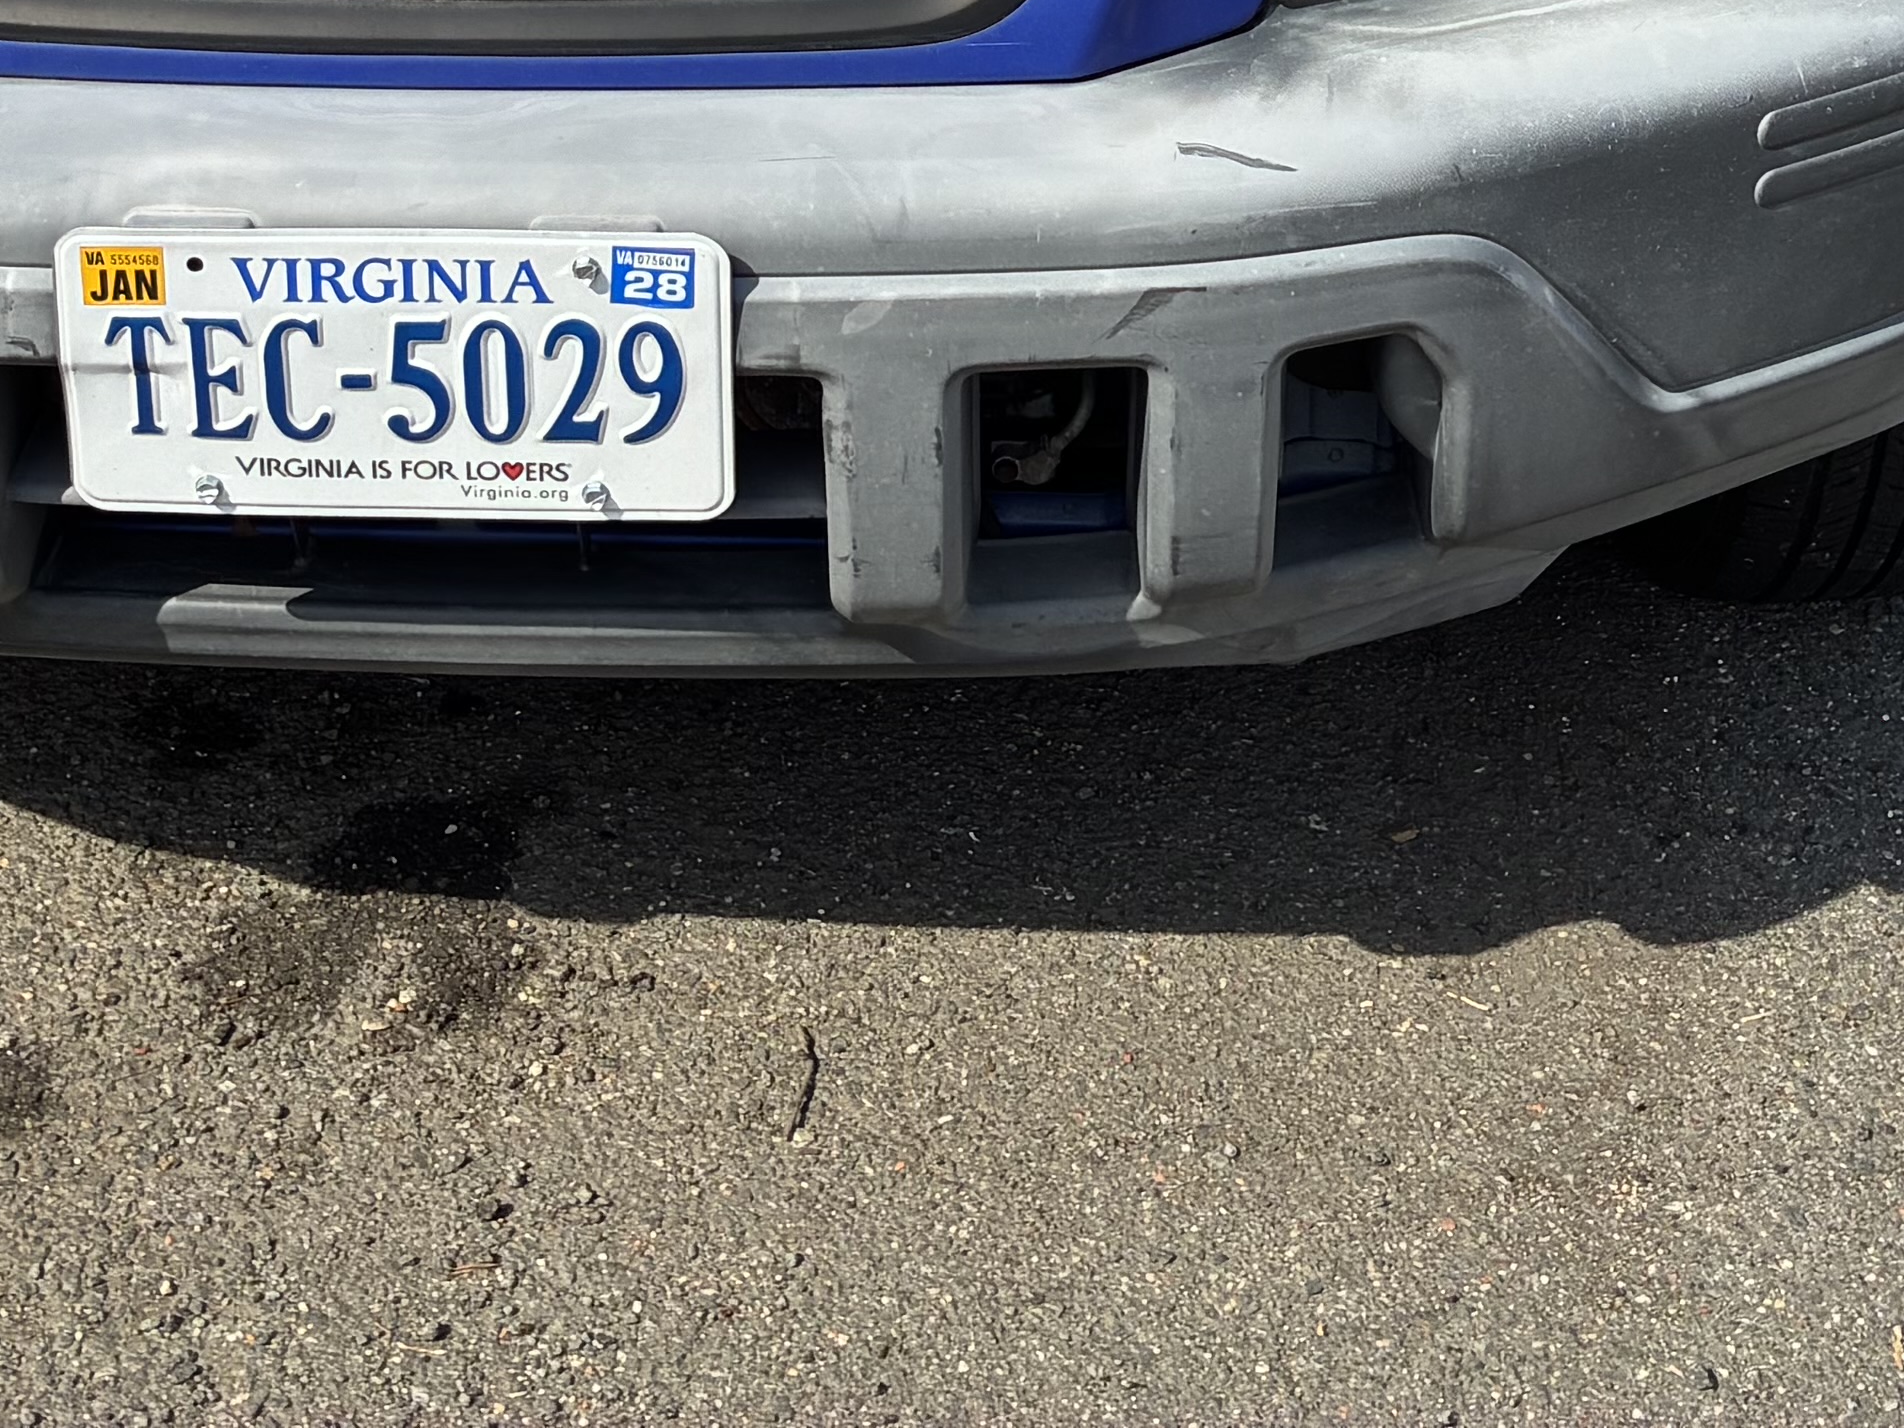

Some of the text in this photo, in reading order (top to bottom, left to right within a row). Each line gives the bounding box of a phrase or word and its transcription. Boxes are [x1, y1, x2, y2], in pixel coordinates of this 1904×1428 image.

[84, 250, 105, 266] VA
[616, 249, 633, 266] VA
[90, 269, 159, 302] JAN
[231, 257, 554, 304] VIRGINIA
[623, 270, 687, 302] 28
[104, 316, 684, 444] TEC-5029
[235, 456, 365, 479] VIRGINIA
[372, 460, 392, 480] IS
[400, 460, 459, 480] FOR
[460, 484, 570, 502] Virginia.org
